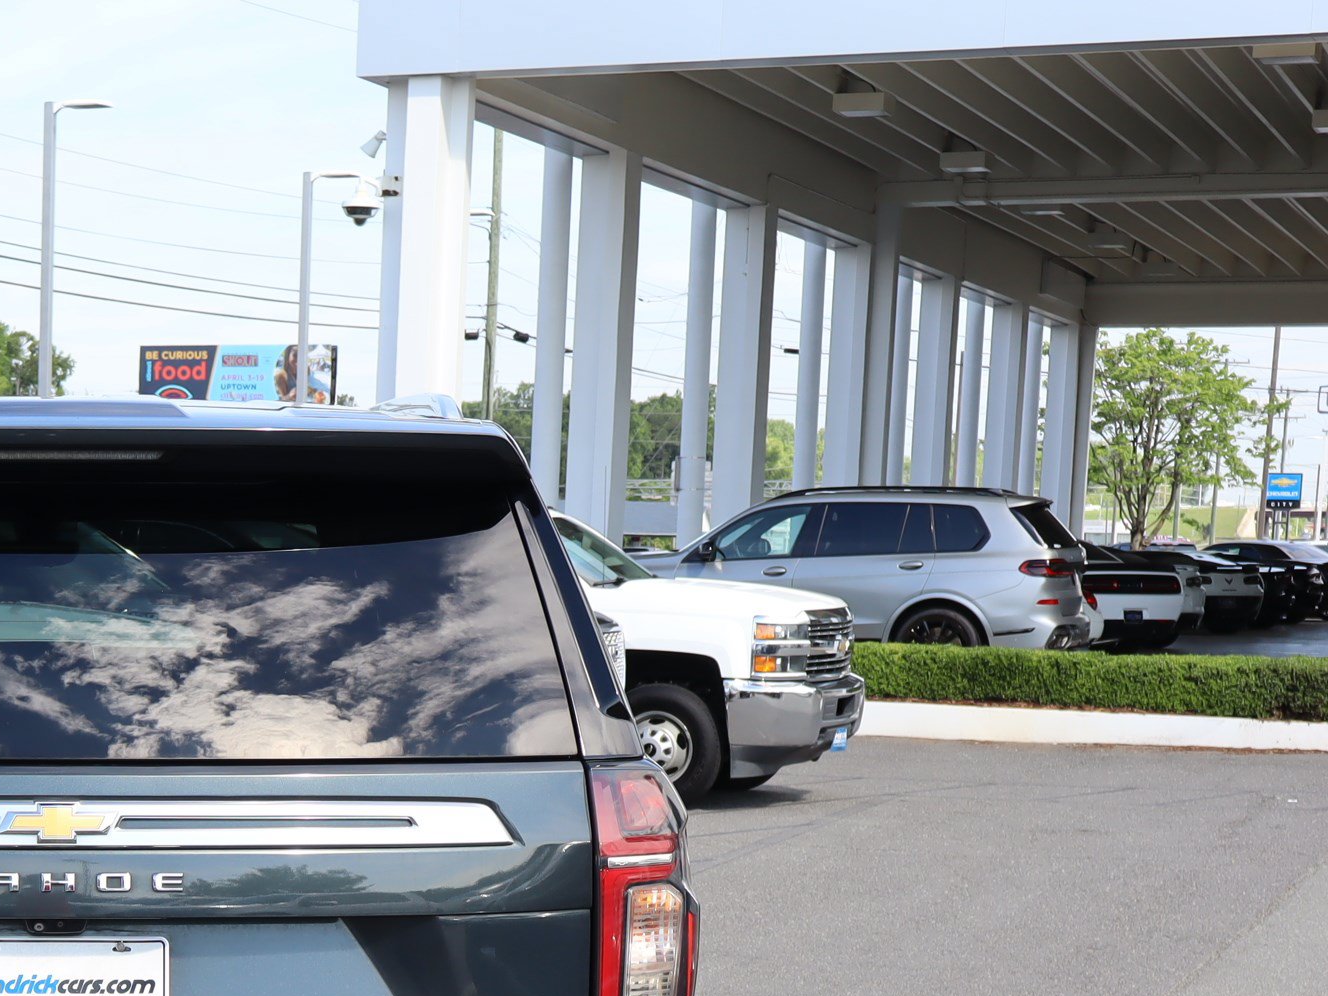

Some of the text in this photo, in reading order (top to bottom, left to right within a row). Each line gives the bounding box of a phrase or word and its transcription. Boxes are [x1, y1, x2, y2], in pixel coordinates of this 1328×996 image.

[145, 350, 209, 360] BE CURIOUS
[153, 360, 207, 381] food
